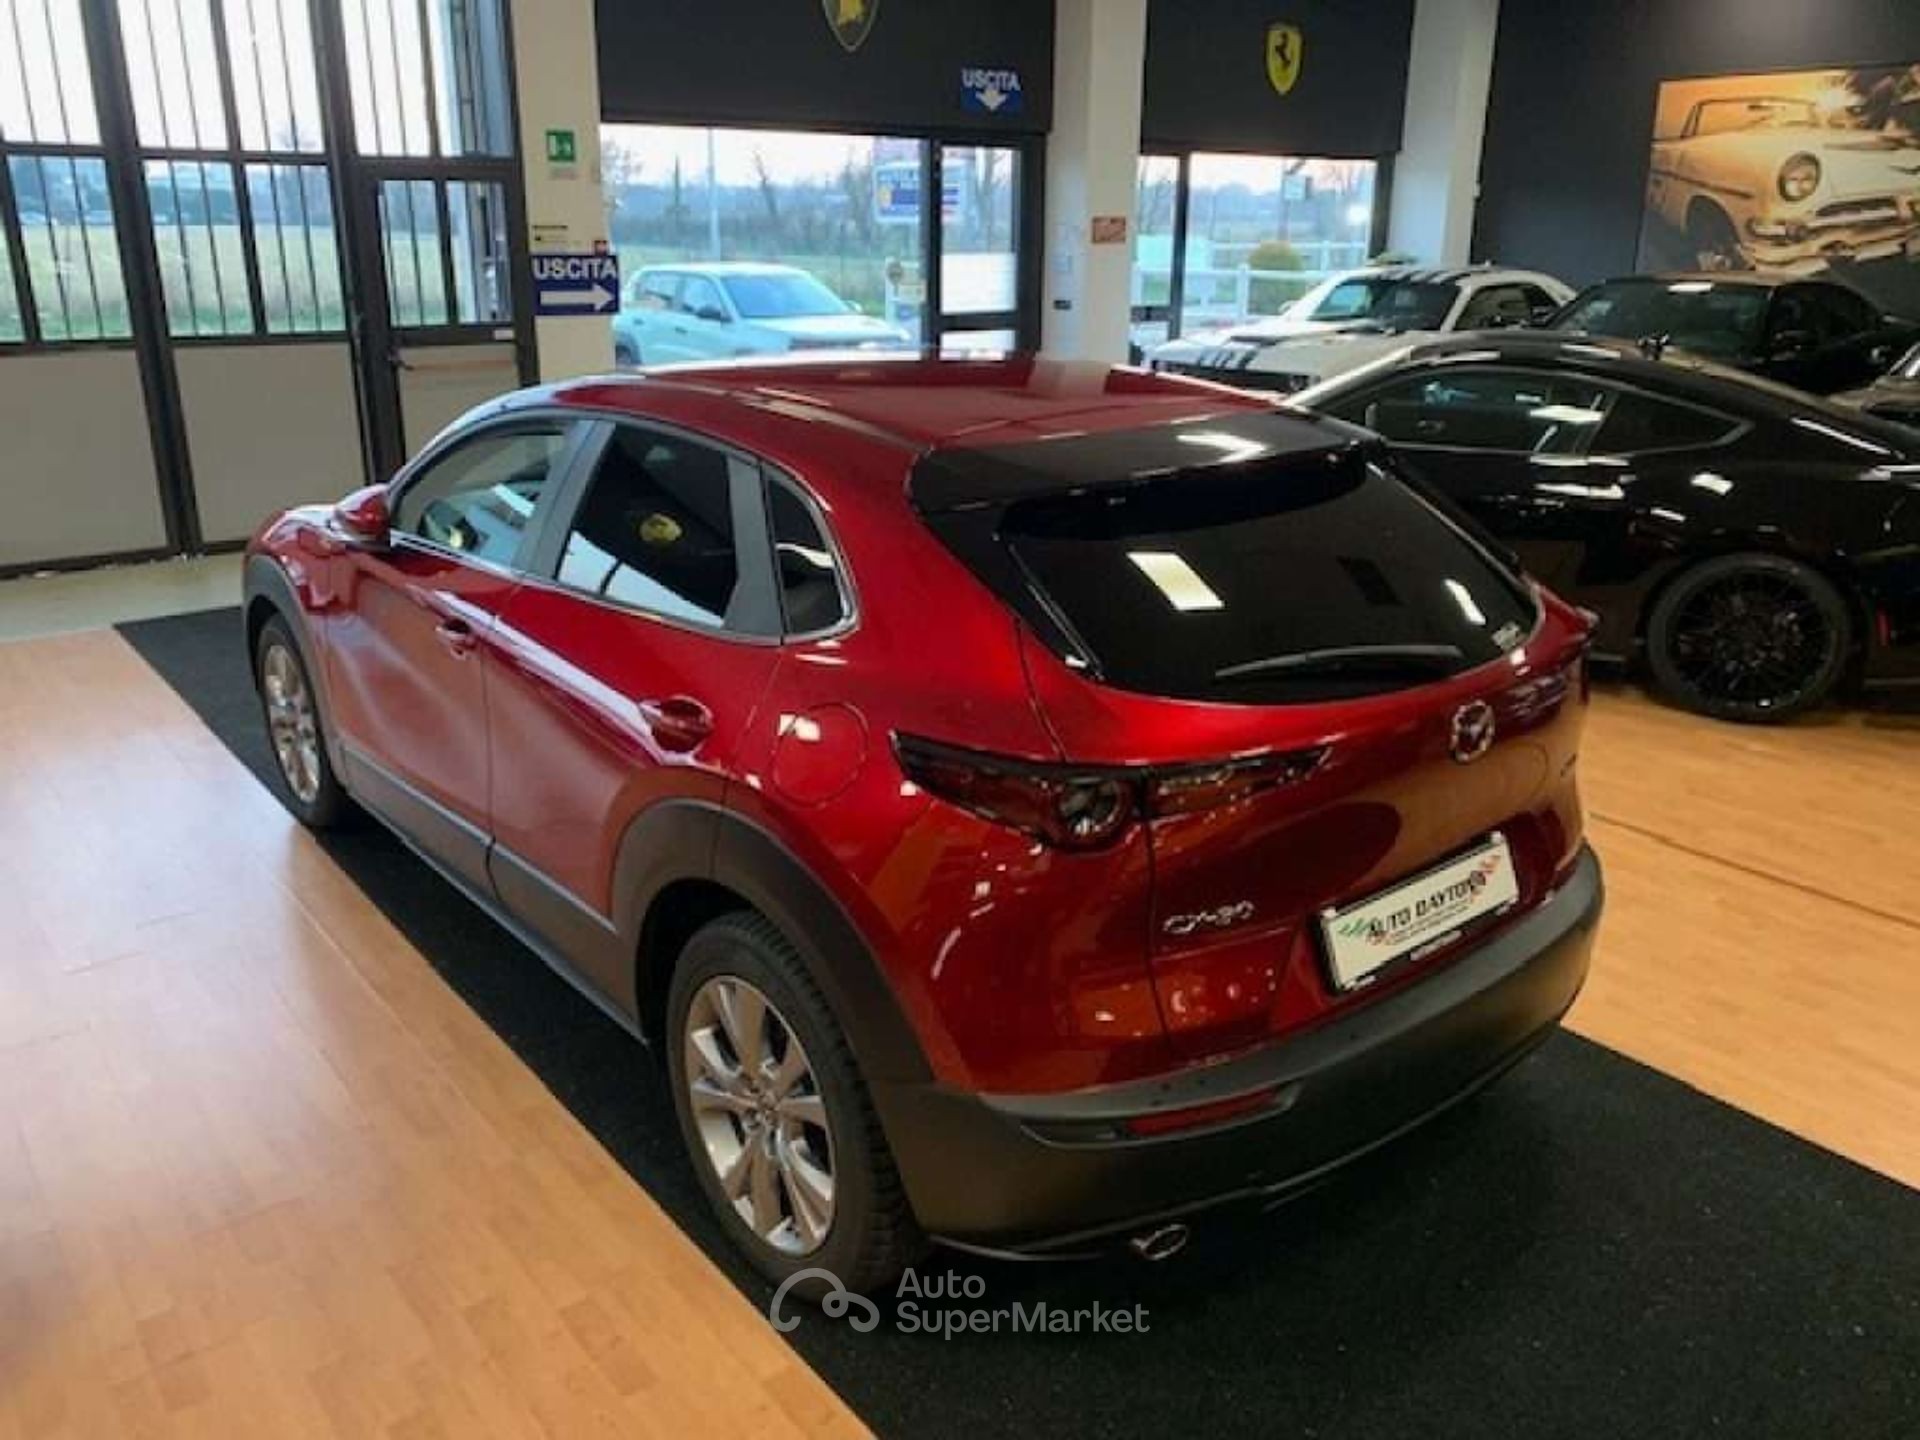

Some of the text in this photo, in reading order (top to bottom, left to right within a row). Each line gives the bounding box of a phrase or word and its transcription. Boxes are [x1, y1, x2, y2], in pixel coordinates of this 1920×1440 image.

[961, 68, 1021, 91] USCITA
[533, 256, 617, 280] USCITA
[1369, 907, 1411, 937] AUTO
